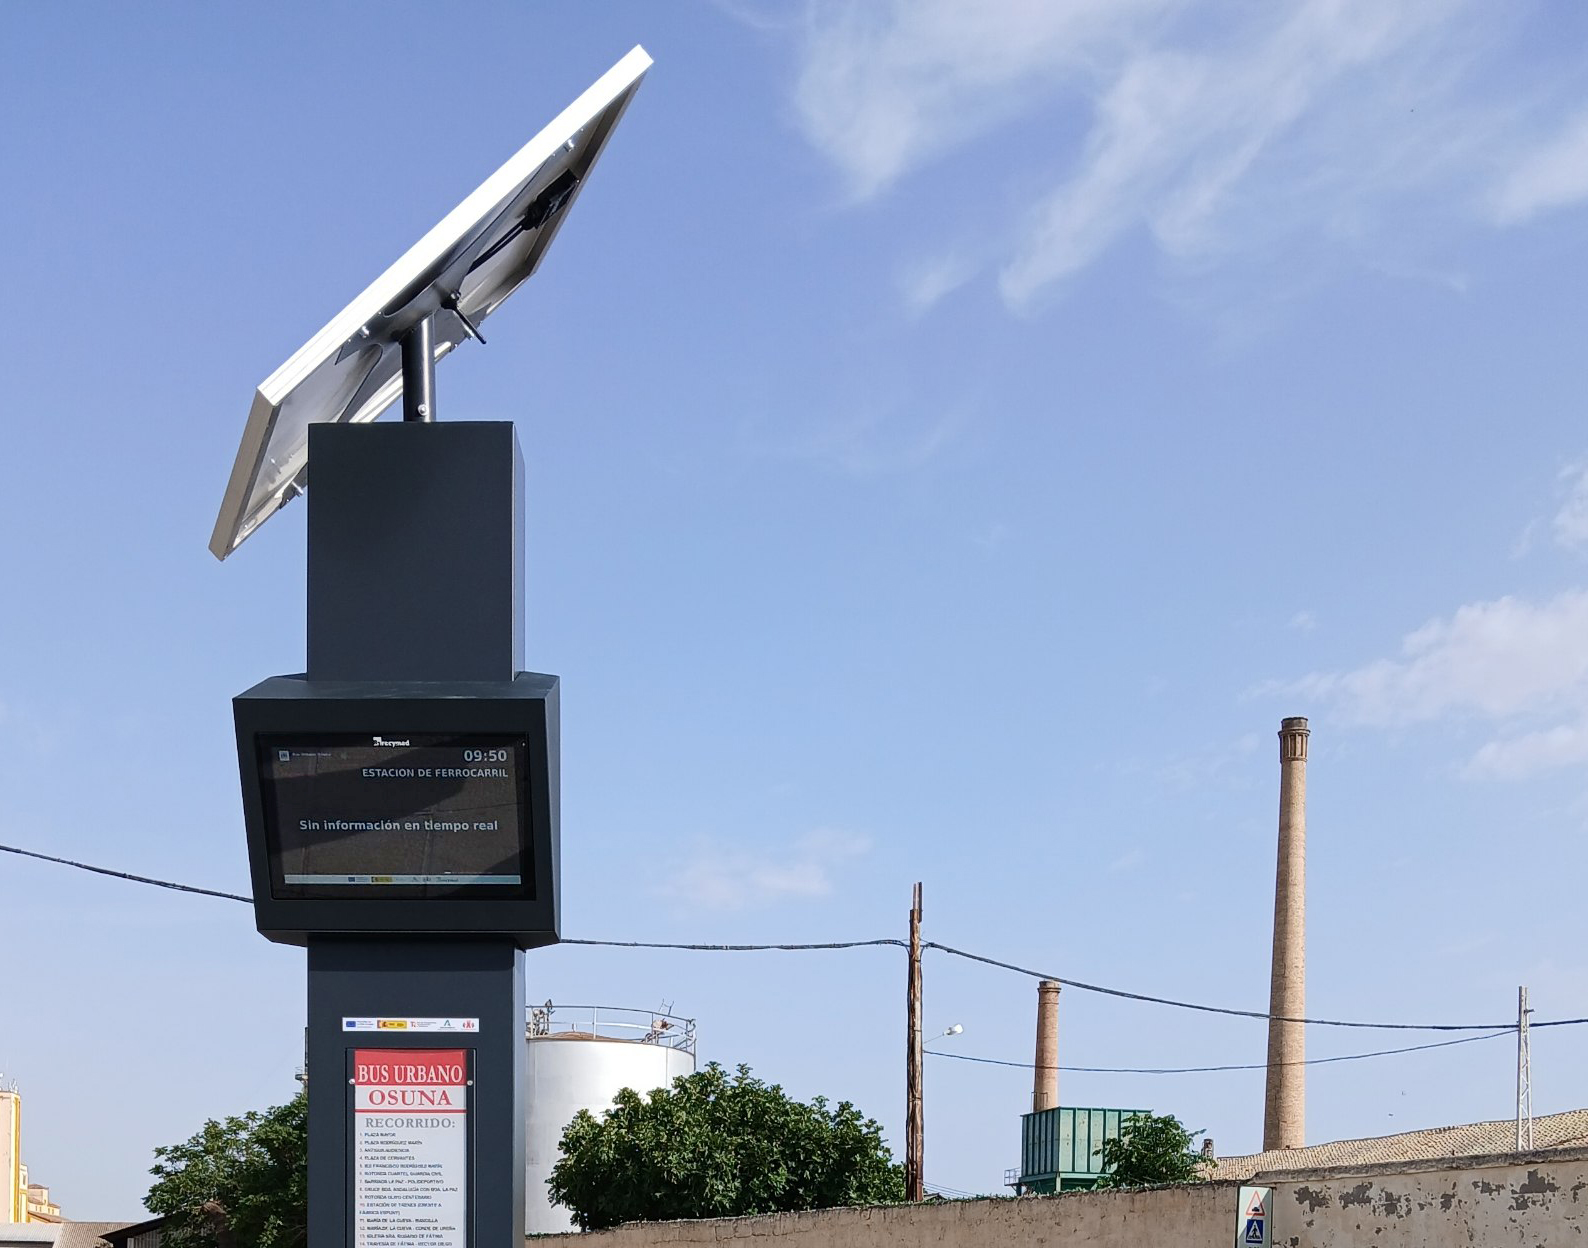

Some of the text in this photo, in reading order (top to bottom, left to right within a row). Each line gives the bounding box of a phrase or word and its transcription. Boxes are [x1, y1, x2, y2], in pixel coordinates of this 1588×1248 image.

[464, 750, 507, 762] 09:50
[363, 768, 508, 778] ESTACION DE FERROCARRIL
[300, 820, 498, 832] Sin información en tiempo real
[358, 1065, 462, 1083] BUS URBANO
[369, 1089, 452, 1106] OSUNA
[366, 1118, 455, 1128] RECORRIDO:
